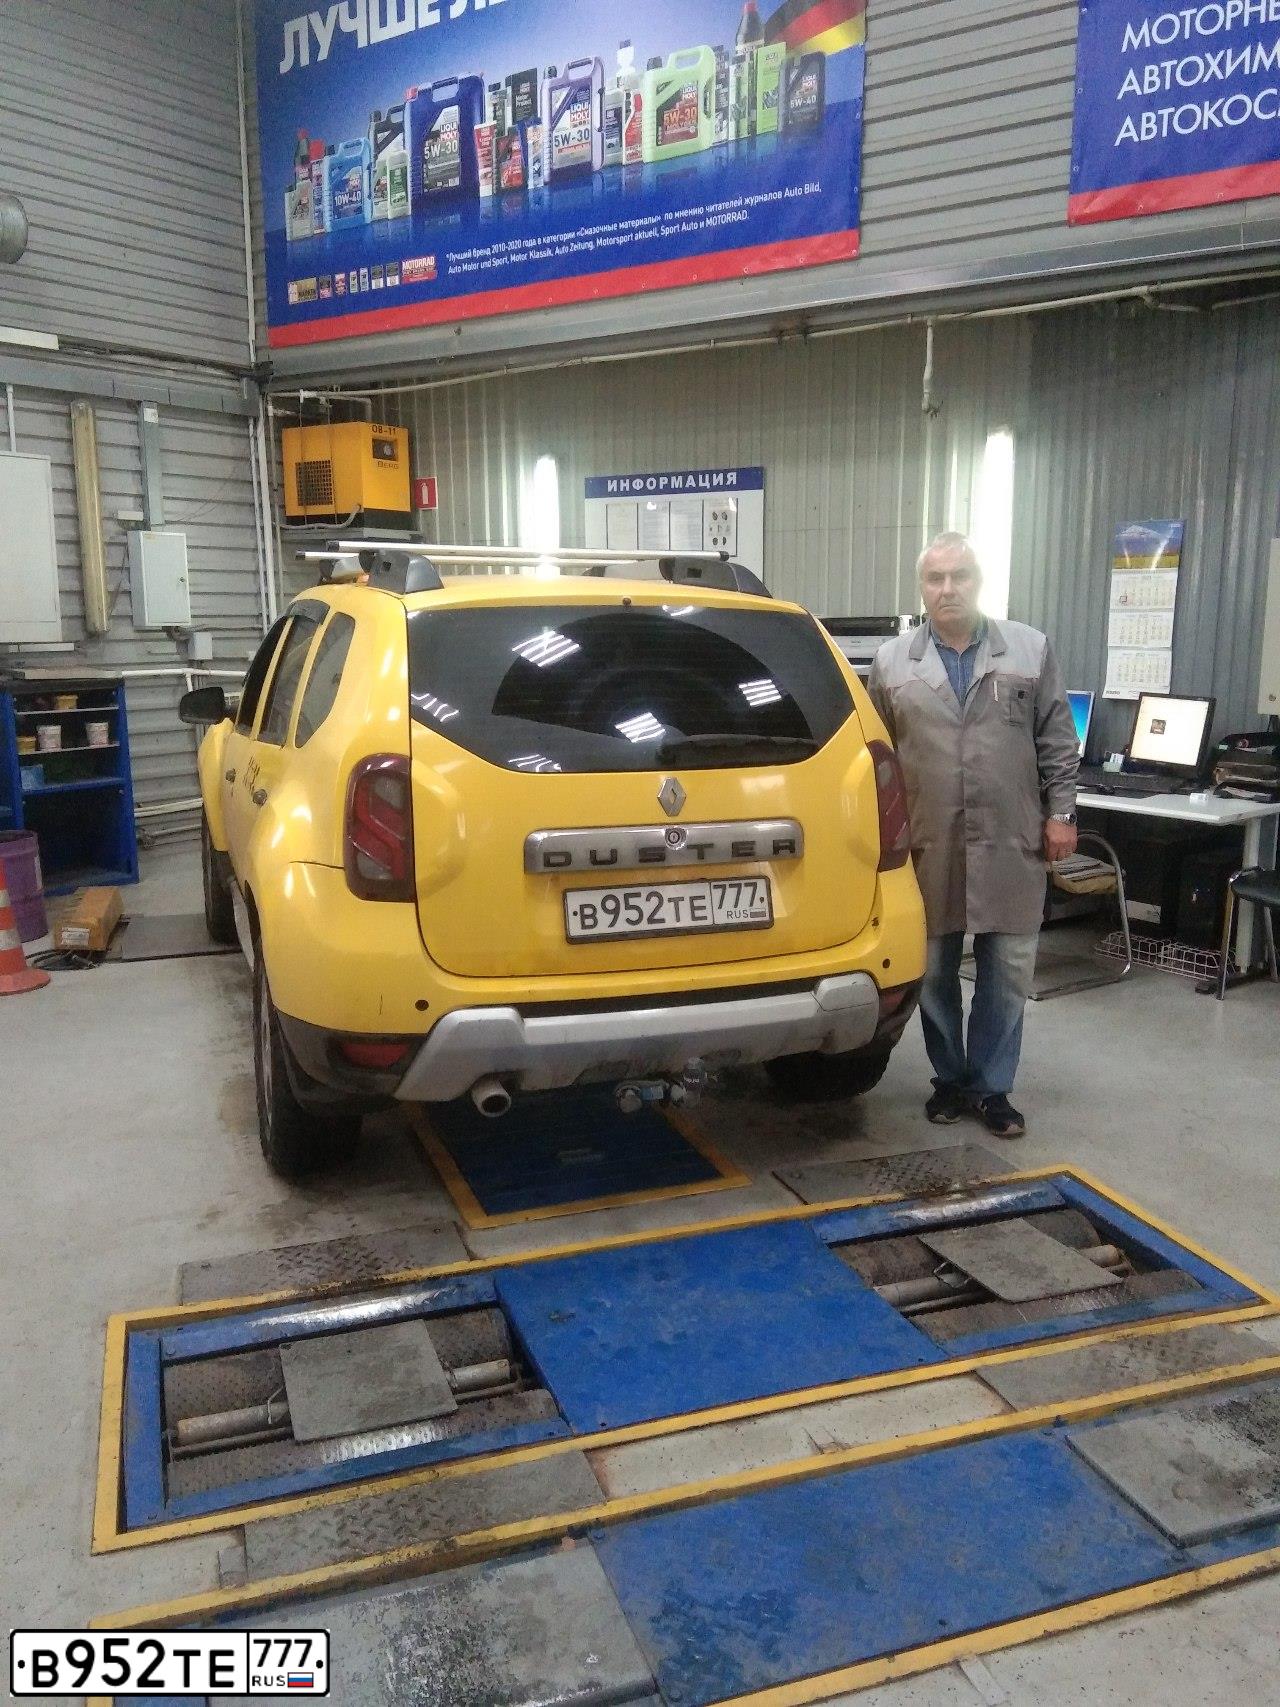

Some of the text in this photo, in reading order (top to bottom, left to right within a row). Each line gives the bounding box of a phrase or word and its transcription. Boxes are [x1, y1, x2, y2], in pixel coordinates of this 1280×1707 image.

[279, 0, 441, 75] ЛУЧШЕ
[569, 101, 590, 113] LIQUI
[570, 110, 590, 122] MOLY
[664, 106, 697, 127] 5W-30
[440, 121, 458, 132] LIQUI
[1114, 88, 1280, 147] АВТОКОС
[440, 130, 458, 140] MOLY
[554, 127, 590, 148] 5W-30
[424, 140, 458, 160] 5W-30
[334, 190, 362, 206] 10W-40
[472, 247, 491, 259] бренд
[491, 239, 522, 254] 2010-2020
[522, 238, 537, 248] года
[542, 231, 576, 243] категории
[576, 222, 618, 237] «Смазочные
[619, 214, 661, 230] материалы»
[664, 212, 673, 221] по
[674, 206, 704, 219] мнению
[705, 196, 743, 213] читателей
[743, 190, 783, 207] журналов
[783, 186, 803, 198] Auto
[804, 181, 822, 194] Bild,
[448, 264, 462, 275] Auto
[462, 261, 480, 272] Motor
[480, 258, 492, 269] und
[554, 246, 569, 256] Auto
[596, 233, 634, 247] Motorsport
[634, 226, 659, 241] aktuell,
[660, 223, 680, 237] Sport
[681, 221, 699, 232] Auto
[705, 209, 750, 227] MOTORRAD.
[402, 256, 435, 271] MOTORRAD
[607, 472, 737, 492] ИНФОРМАЦИЯ
[543, 839, 796, 868] DUSTER
[579, 881, 758, 930] В952ТЕ 777
[726, 909, 749, 920] RUS
